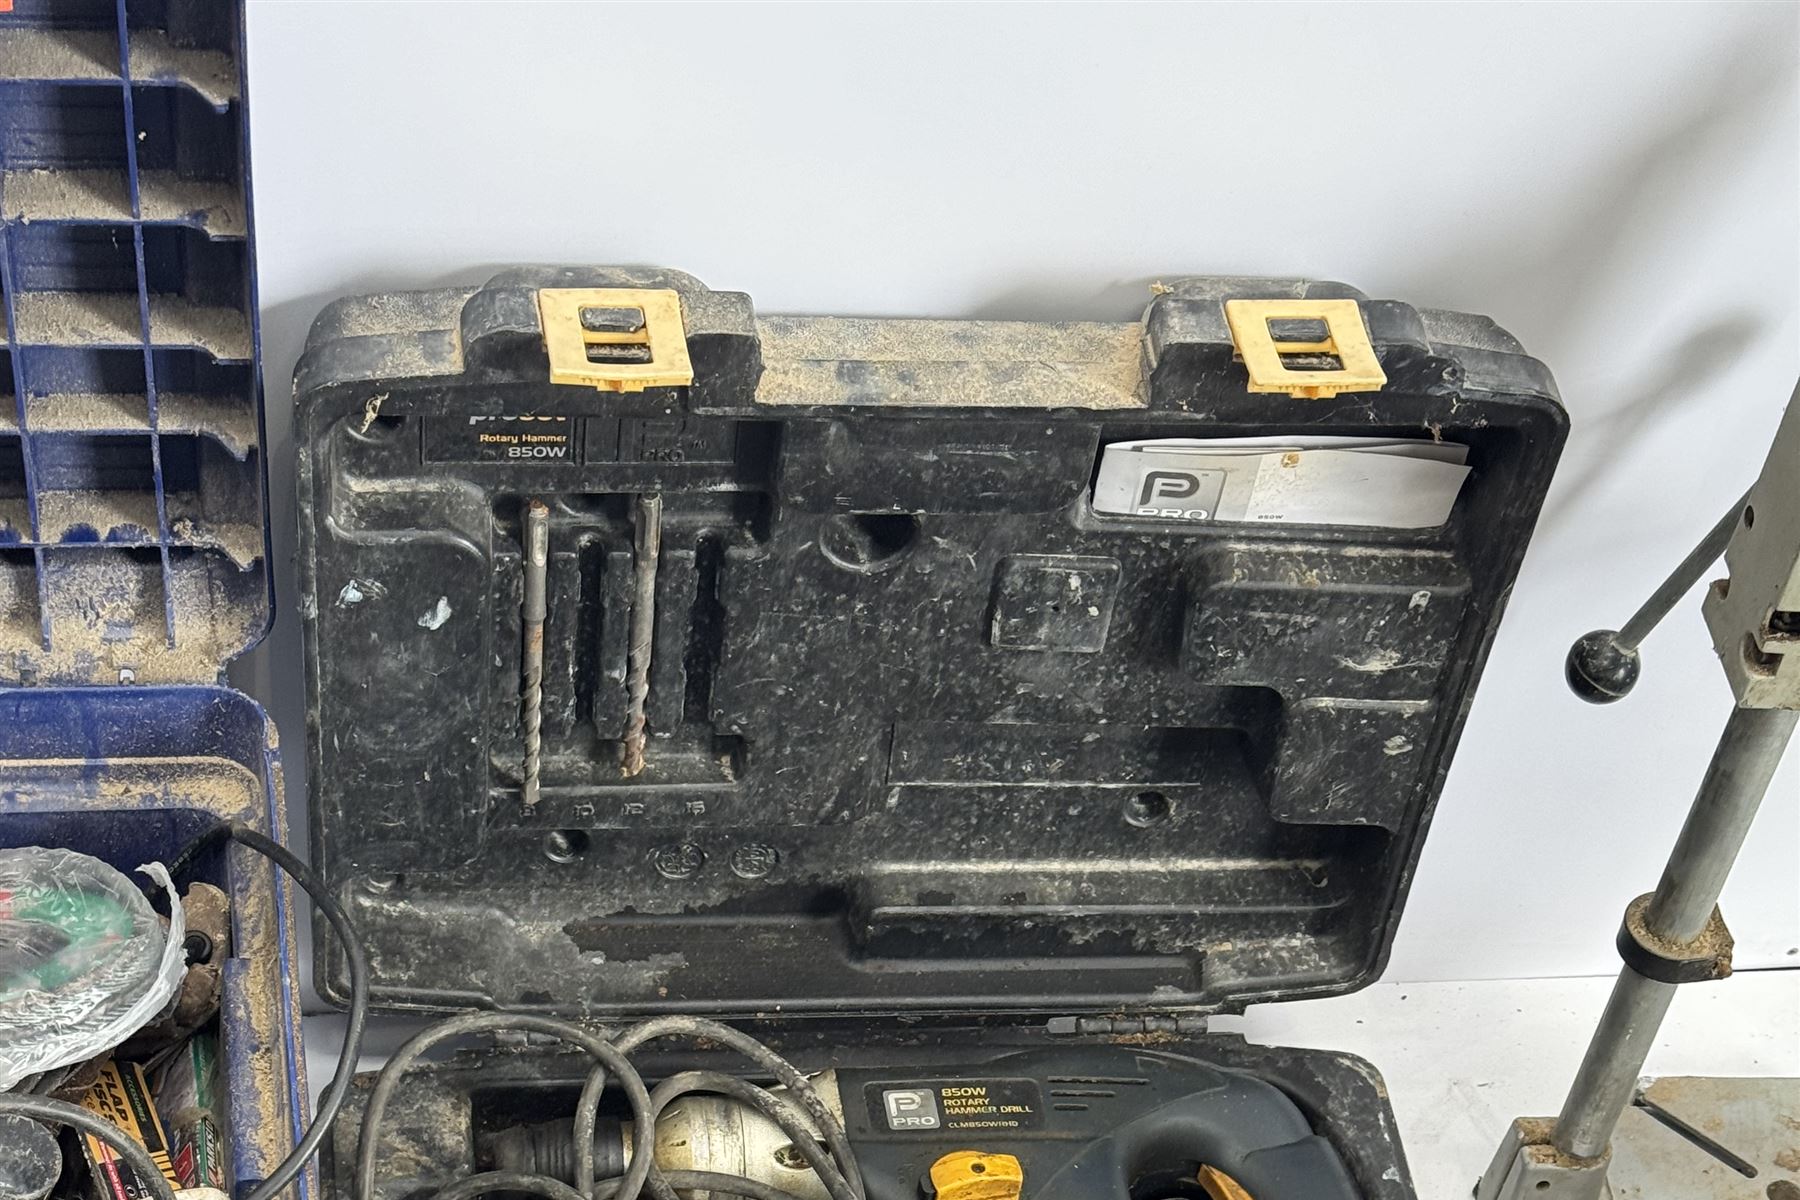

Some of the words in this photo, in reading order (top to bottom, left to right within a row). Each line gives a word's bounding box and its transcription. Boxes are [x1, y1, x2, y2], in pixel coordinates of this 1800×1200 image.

[480, 434, 518, 443] Rotary
[522, 434, 567, 442] Hammer
[508, 446, 566, 457] 850W
[1136, 508, 1209, 520] PRO
[100, 1070, 129, 1122] FLAP
[941, 1087, 987, 1097] 850W
[943, 1098, 990, 1107] ROTARY
[945, 1106, 997, 1115] HAMMER
[1000, 1105, 1034, 1113] DRILL
[892, 1116, 936, 1127] PRO
